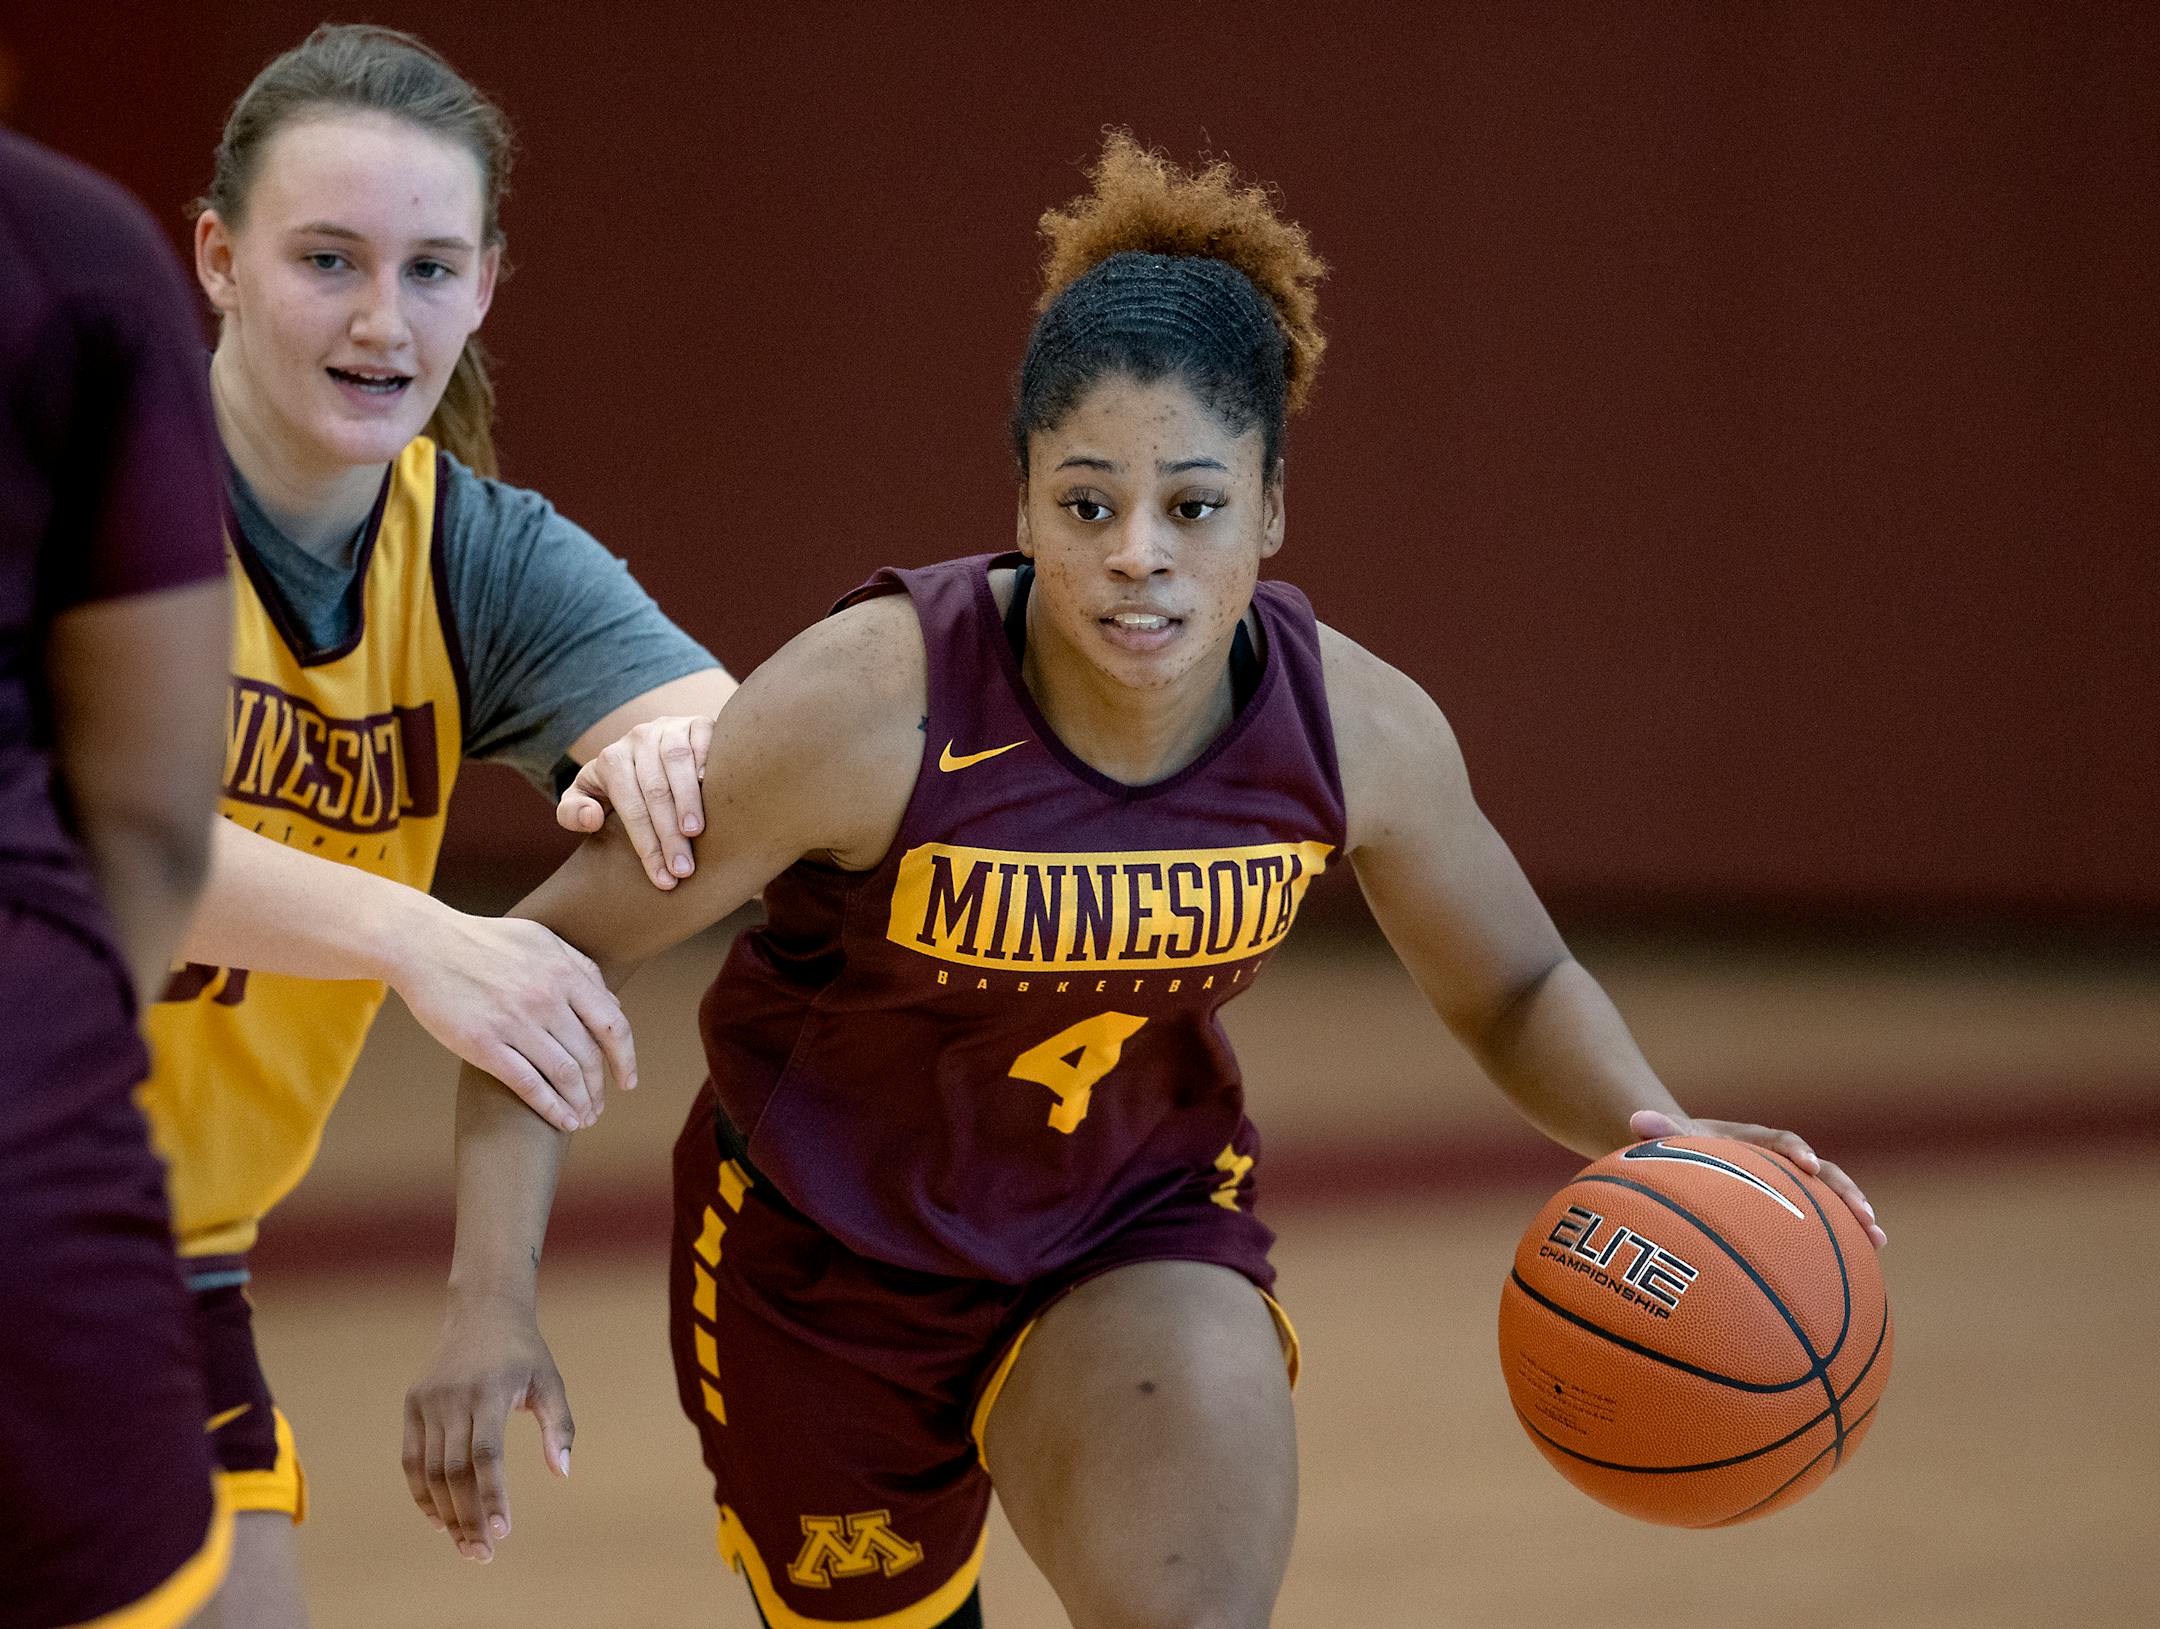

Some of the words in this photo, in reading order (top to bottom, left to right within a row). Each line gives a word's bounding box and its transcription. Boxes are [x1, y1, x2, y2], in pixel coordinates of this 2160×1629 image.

[916, 853, 1303, 962] MINNESOTA
[1008, 1010, 1149, 1134] 4
[1538, 1245, 1671, 1320] CHAMPIONSHIP
[1548, 1205, 1699, 1310] ELITE
[786, 1508, 925, 1589] M
